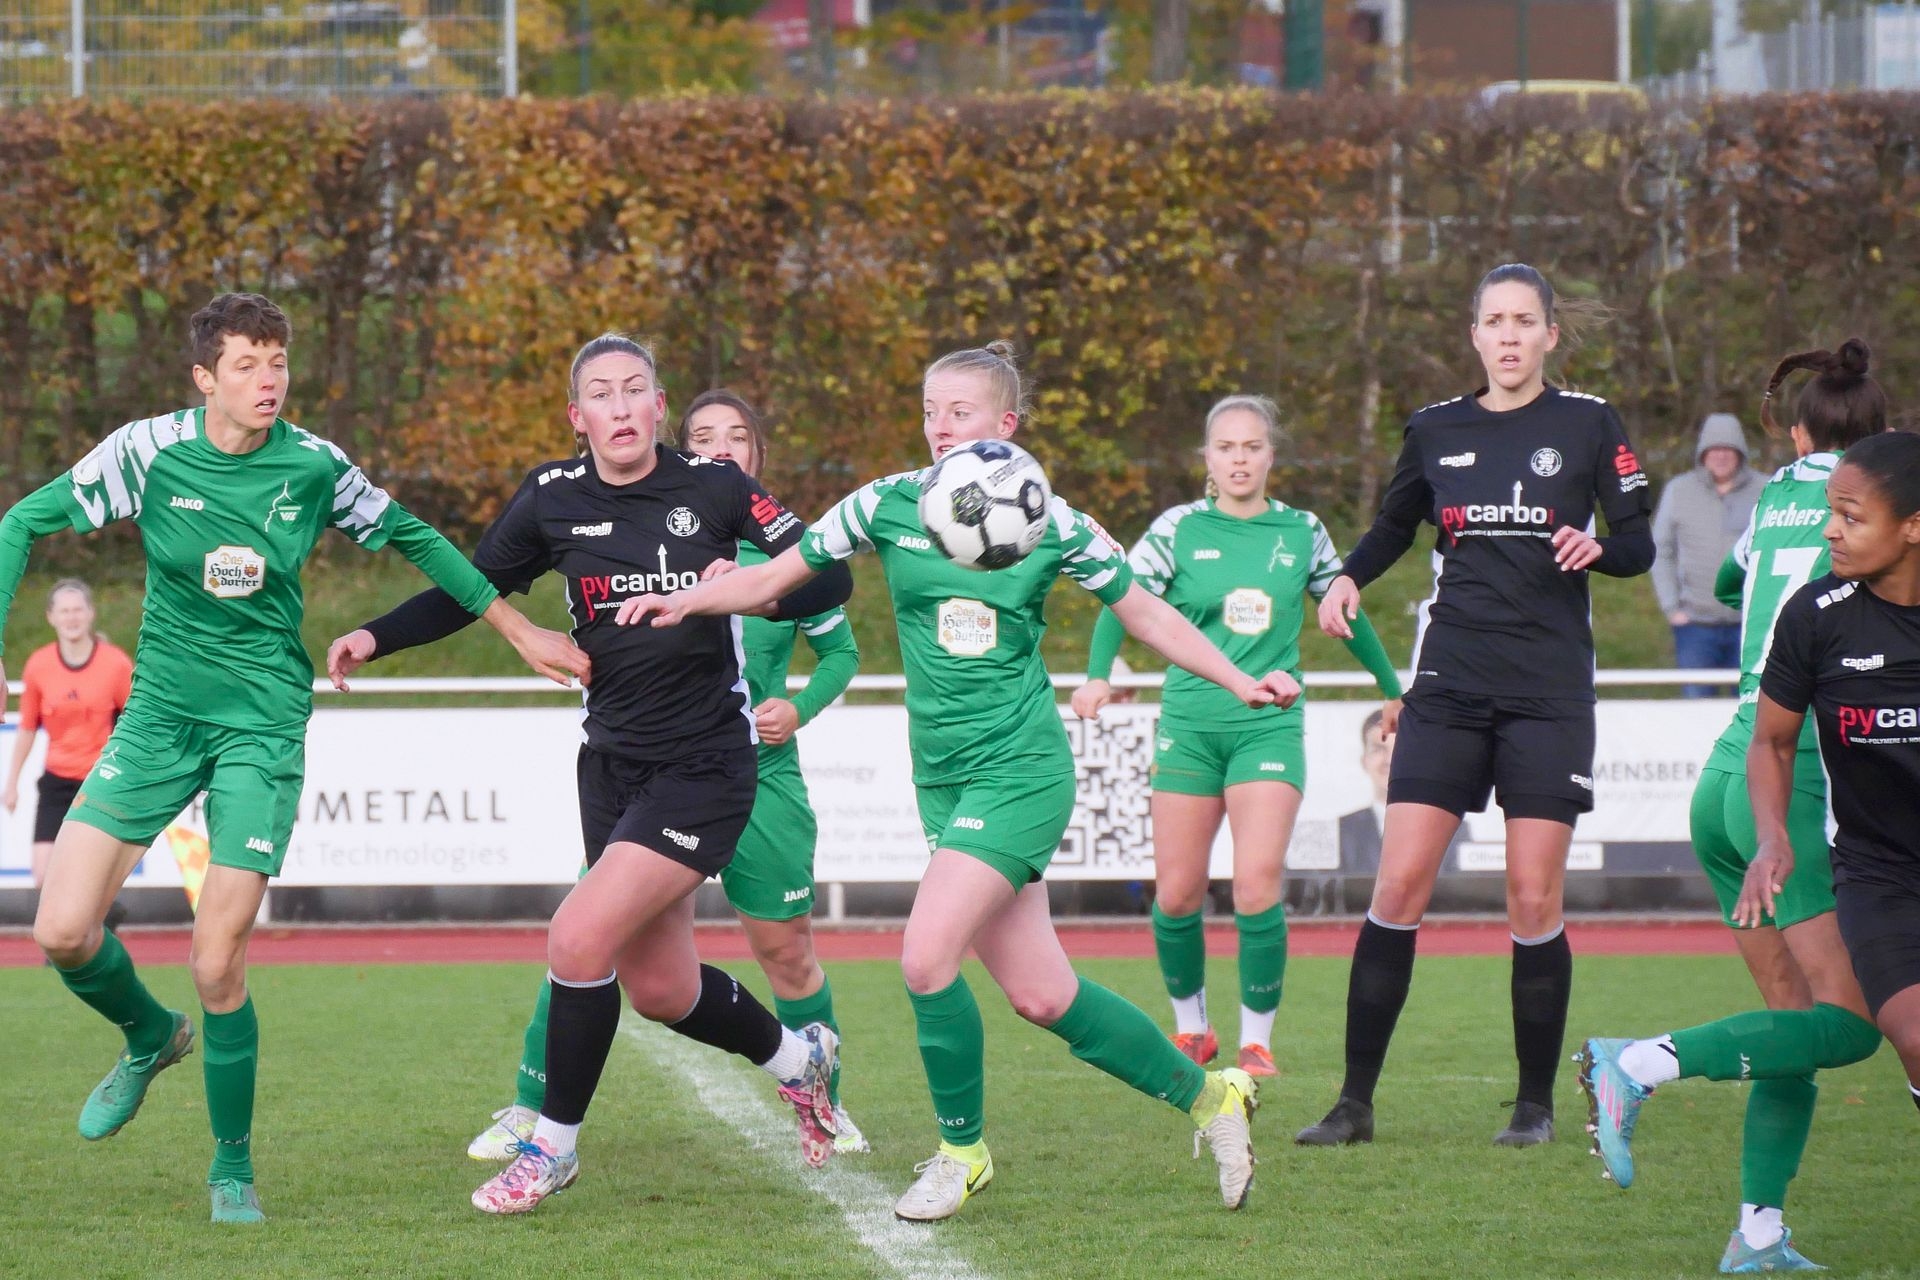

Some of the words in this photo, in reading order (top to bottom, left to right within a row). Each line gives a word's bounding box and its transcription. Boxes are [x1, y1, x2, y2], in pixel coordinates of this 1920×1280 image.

[169, 496, 204, 511] JAKO
[571, 522, 613, 537] capelli
[896, 535, 931, 550] JAKO
[220, 552, 244, 565] Das
[1193, 549, 1221, 560] JAKO
[208, 563, 242, 578] Hoch
[220, 576, 259, 589] dorfer
[1740, 547, 1824, 674] 17
[1841, 654, 1885, 671] capelli
[1839, 706, 1920, 738] pyca
[1259, 762, 1286, 772] JAKO
[1593, 760, 1698, 783] MENSBER
[952, 816, 984, 830] JAKO
[245, 837, 274, 856] JAKO
[661, 827, 700, 851] capelli
[317, 842, 509, 873] Technologies
[783, 886, 810, 902] JAKO
[519, 1063, 547, 1083] AKO
